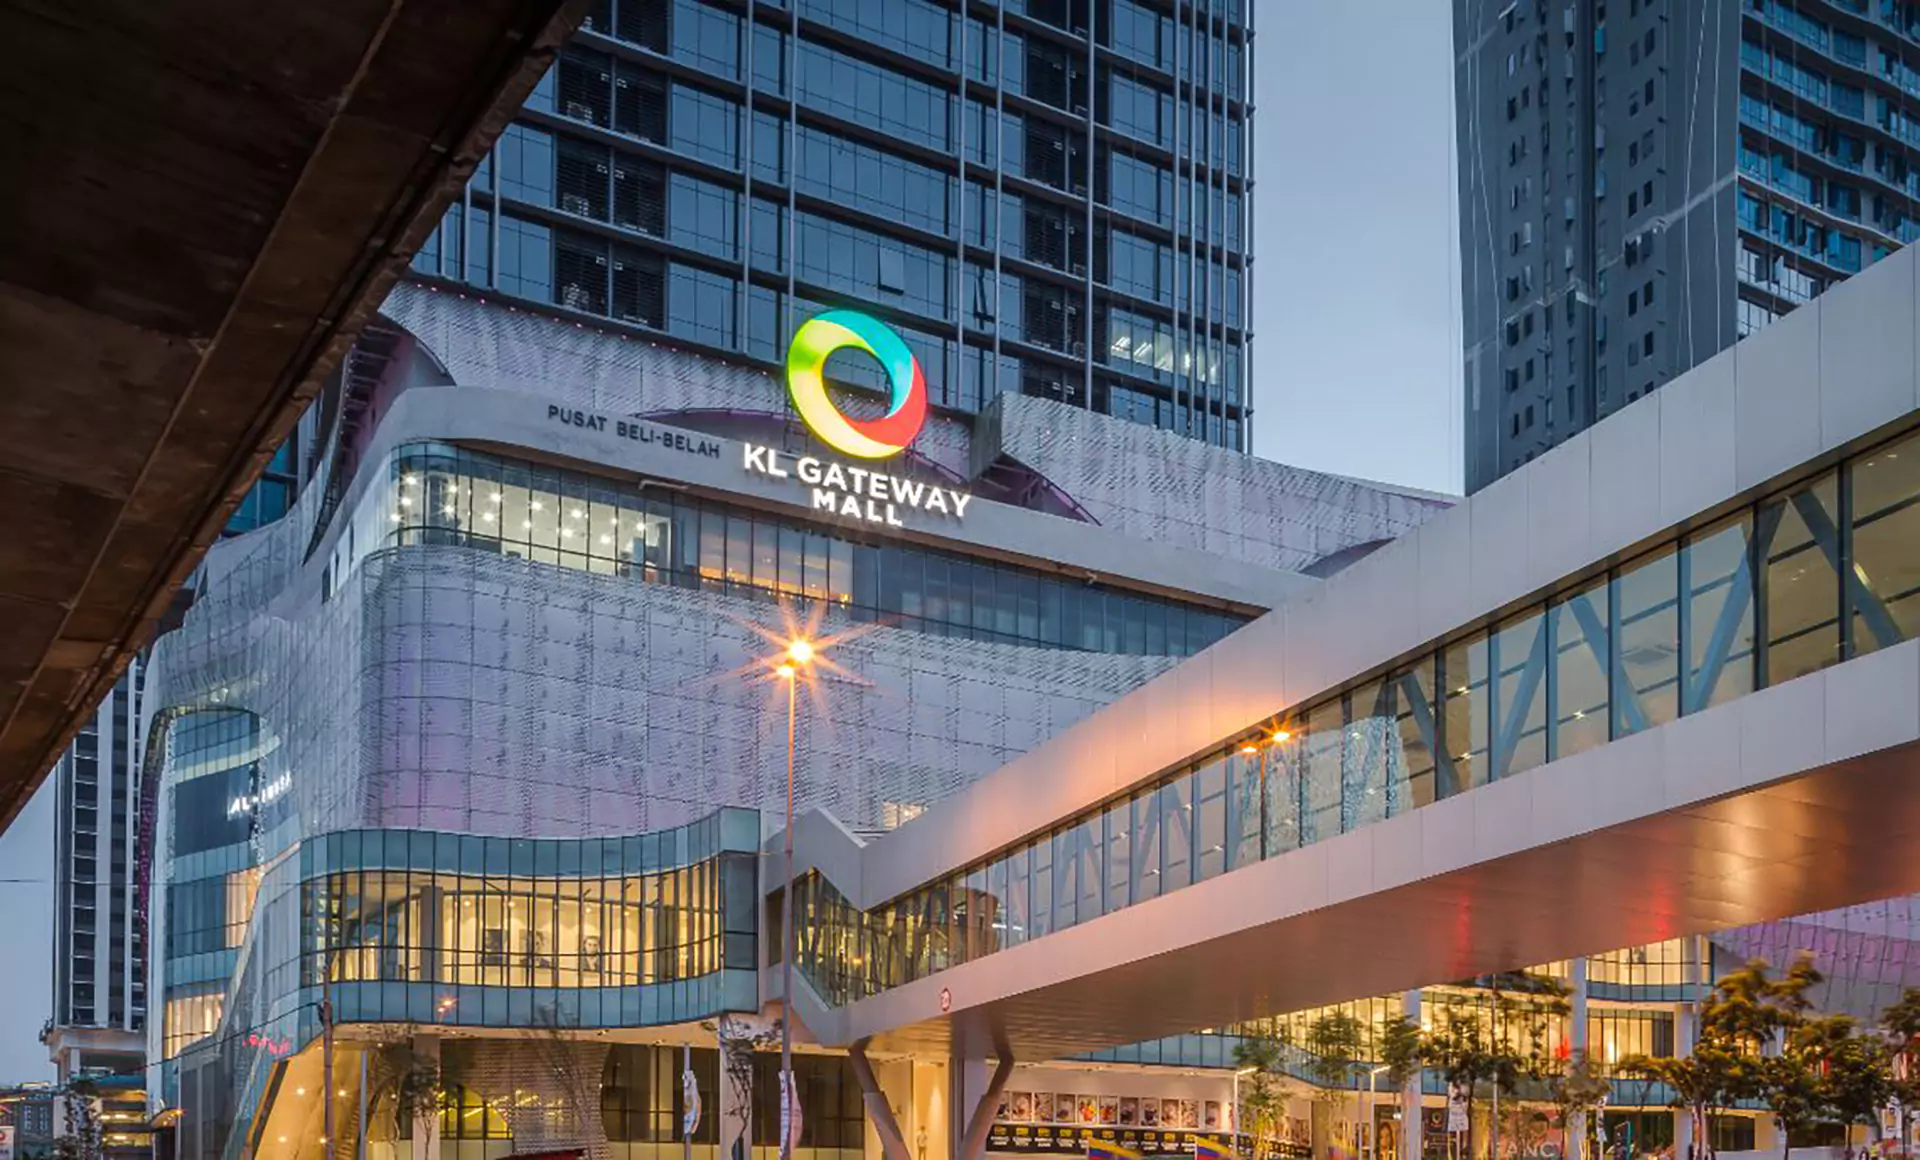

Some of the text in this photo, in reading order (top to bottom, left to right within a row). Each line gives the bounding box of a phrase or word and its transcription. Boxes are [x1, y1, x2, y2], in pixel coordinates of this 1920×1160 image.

[548, 404, 720, 459] PUSAT BELI-BELAH
[744, 443, 970, 517] KL GATEWAY
[812, 488, 903, 526] MALL
